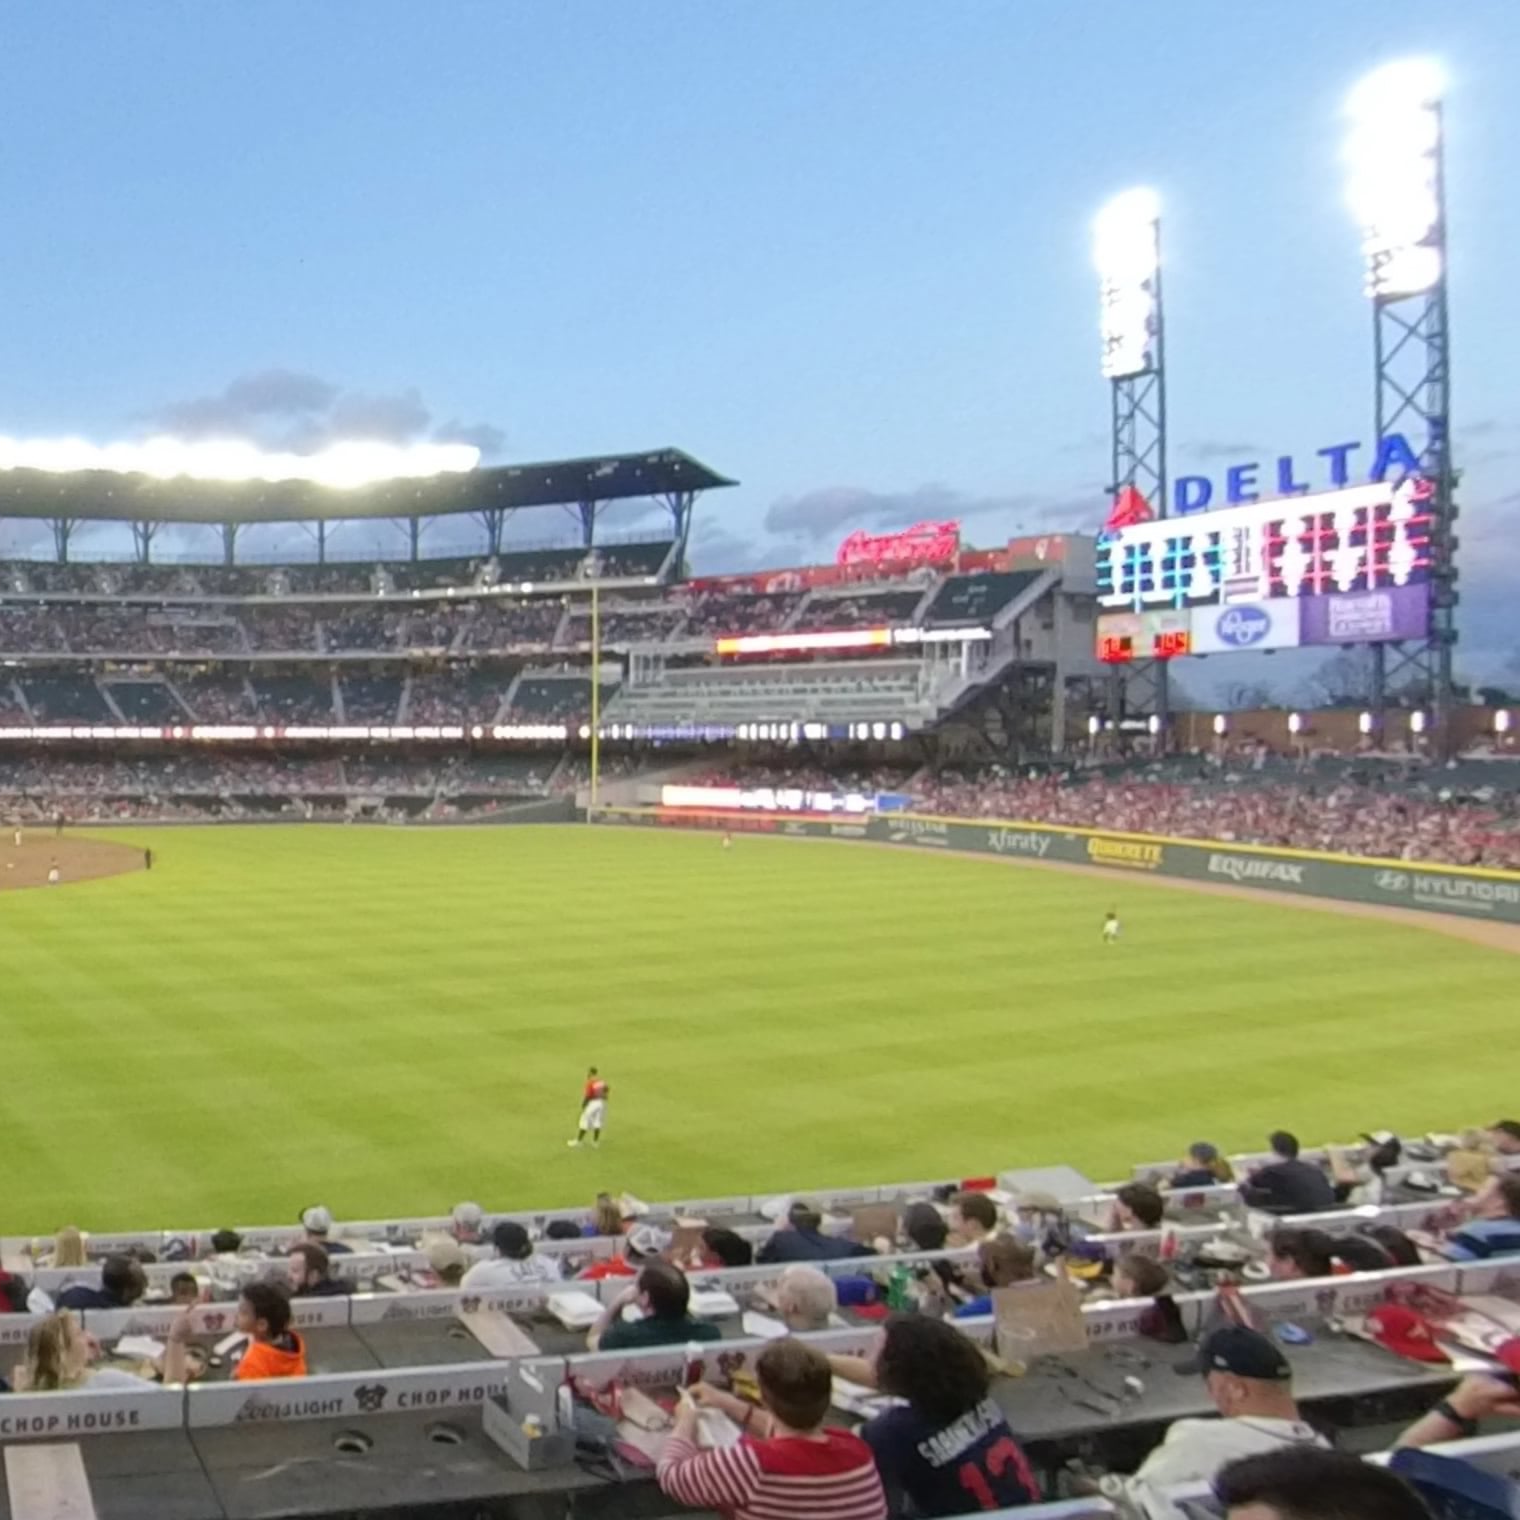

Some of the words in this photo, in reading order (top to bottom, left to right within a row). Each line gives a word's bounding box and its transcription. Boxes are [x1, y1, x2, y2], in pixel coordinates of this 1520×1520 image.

[1174, 433, 1420, 514] DELTA
[988, 829, 1051, 857] xfinity
[1207, 852, 1304, 884] EQUIFAX
[1413, 875, 1520, 904] HYUNDAI
[294, 1399, 344, 1417] LIGHT
[397, 1387, 452, 1408] CHOP
[0, 1415, 60, 1434] CHOP
[66, 1409, 141, 1430] HOUSE
